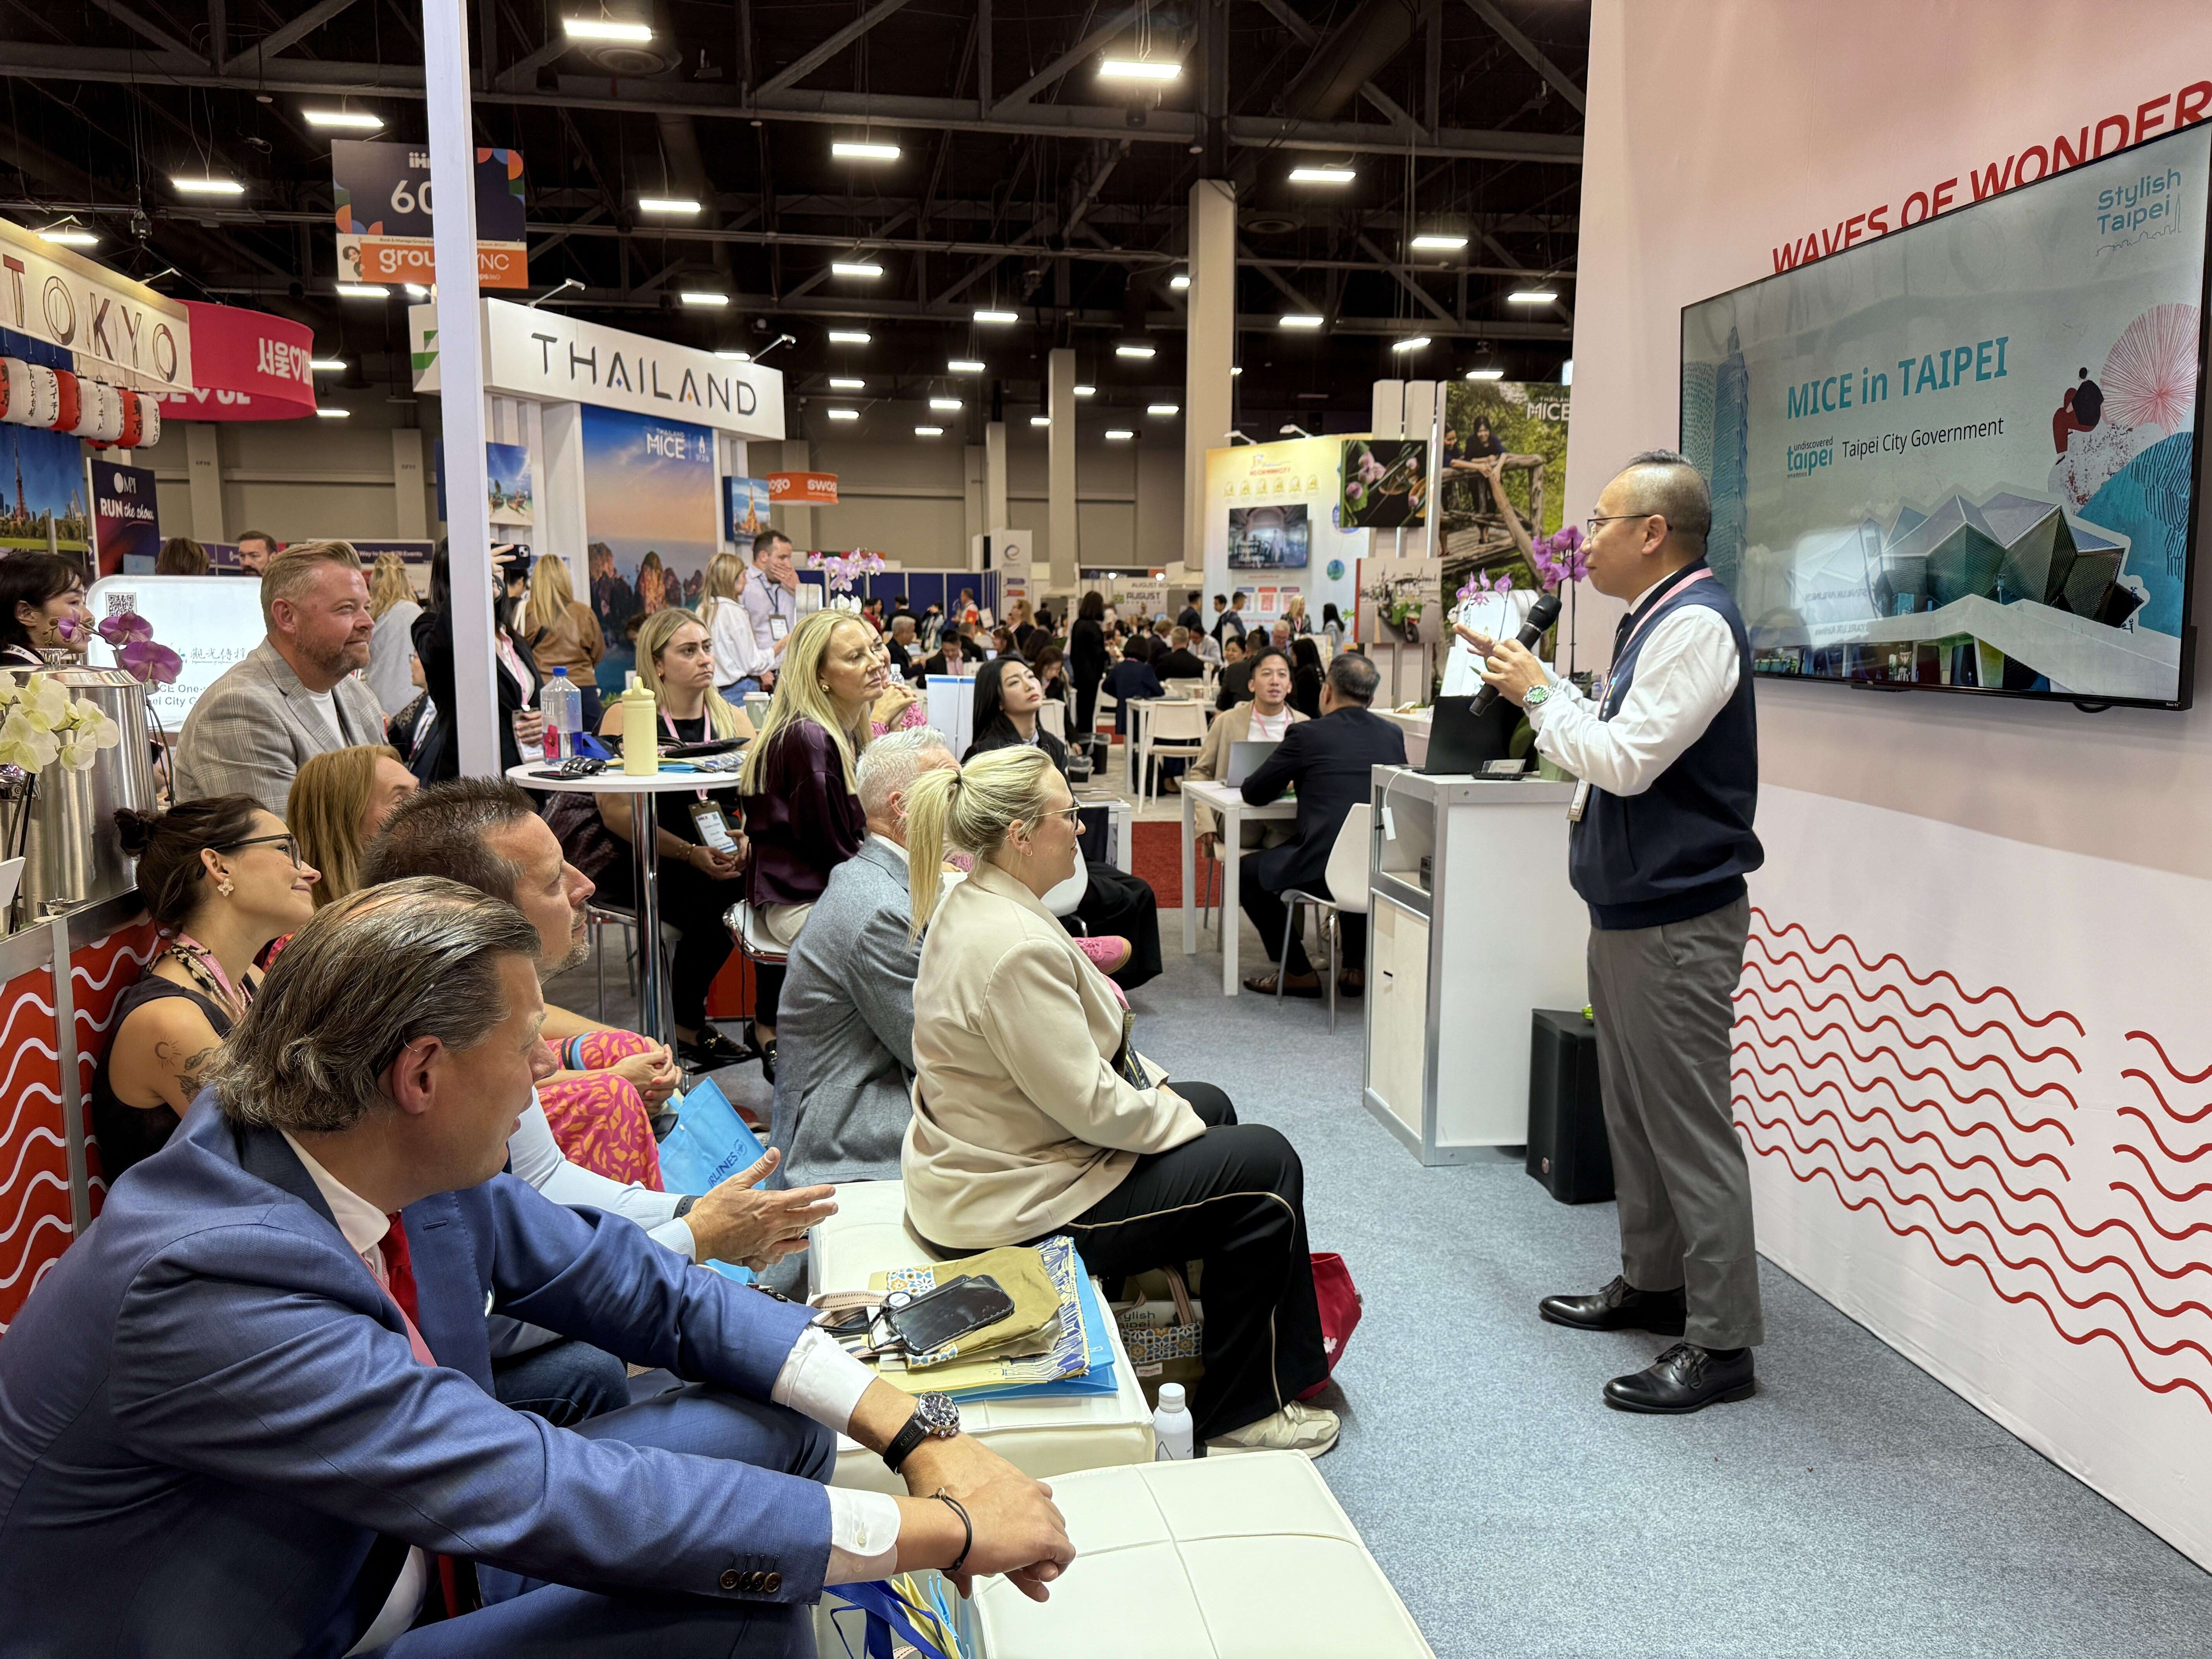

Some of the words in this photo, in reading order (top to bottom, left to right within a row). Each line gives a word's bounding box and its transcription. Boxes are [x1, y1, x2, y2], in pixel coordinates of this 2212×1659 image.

[2097, 168, 2181, 210] Stylish
[1772, 204, 1888, 274] WAVES
[1901, 177, 1958, 228] OF
[2097, 194, 2170, 235] Taipei
[379, 248, 435, 273] grou
[477, 253, 509, 270] NC
[3, 253, 177, 383] TOKYO
[531, 333, 756, 416] THAILAND
[1788, 373, 1853, 419] MICE
[1862, 367, 1887, 404] in
[1898, 337, 2009, 396] TAIPEI
[1527, 402, 1570, 421] MICE
[647, 433, 685, 460] MICE
[1794, 436, 1833, 451] undiscovered
[1843, 436, 1878, 460] Taipei
[1883, 434, 1907, 454] City
[1911, 418, 2004, 447] Government
[1787, 446, 1832, 476] taipei
[124, 476, 137, 494] MPI
[100, 498, 124, 518] RUN
[124, 502, 135, 518] the
[165, 697, 185, 707] City
[204, 955, 223, 977] ERMUDA
[708, 1151, 738, 1188] IRLINES
[1123, 1311, 1156, 1321] ylish
[900, 1425, 918, 1446] ORIS
